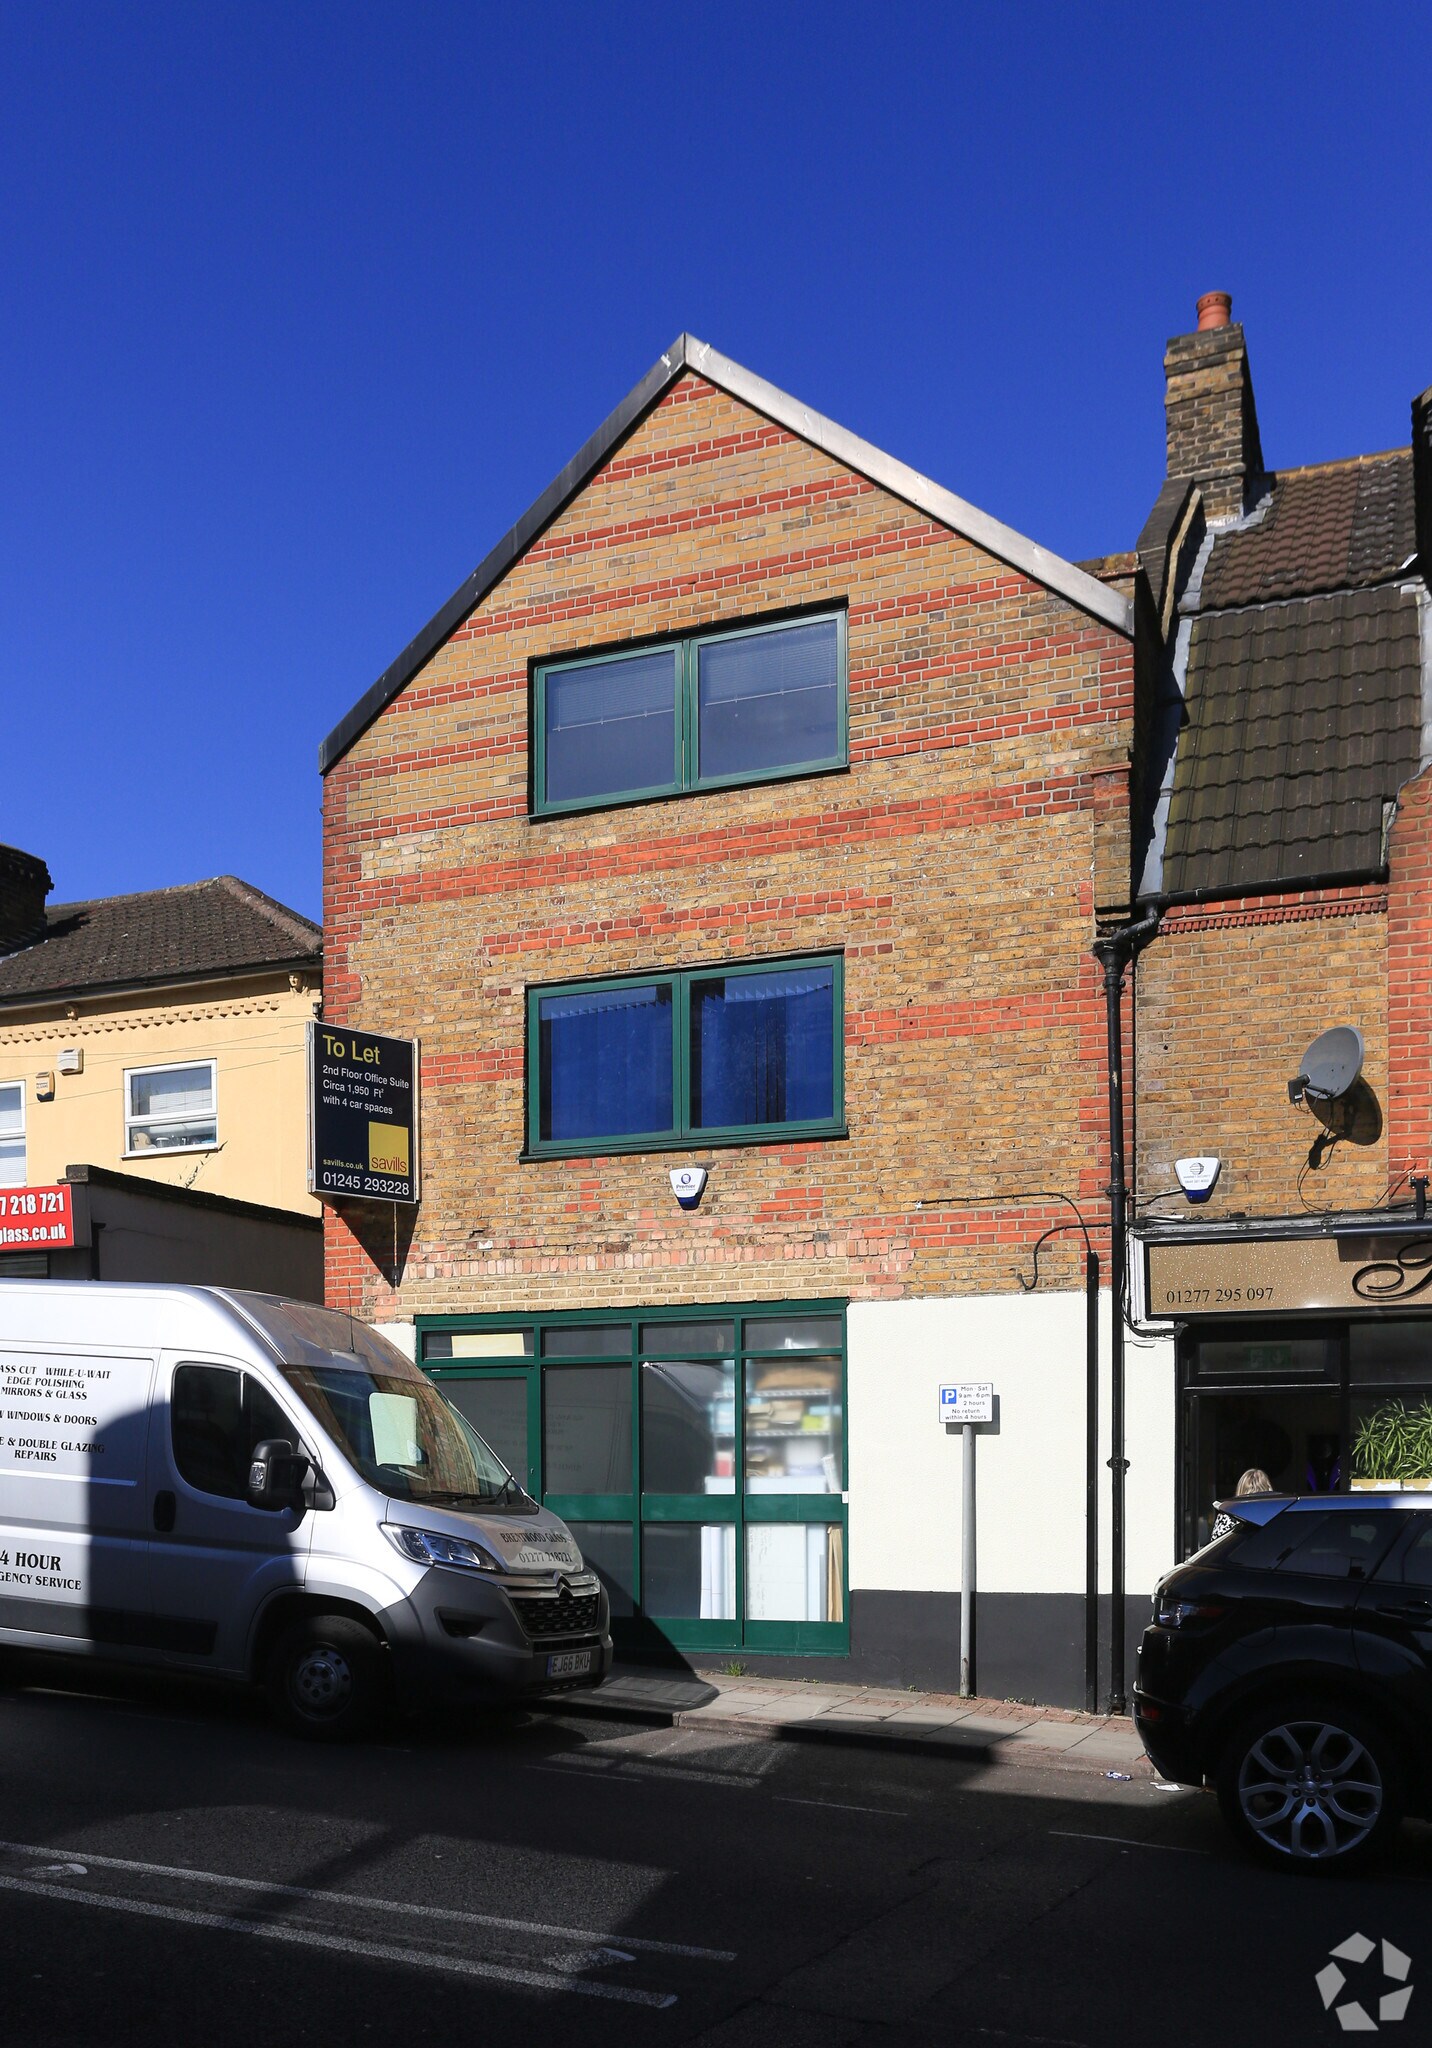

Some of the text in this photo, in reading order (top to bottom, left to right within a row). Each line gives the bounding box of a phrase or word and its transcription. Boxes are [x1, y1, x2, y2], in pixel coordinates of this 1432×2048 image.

[322, 1034, 380, 1065] To Let
[322, 1064, 410, 1089] 2nd Floor Office Suite
[322, 1080, 346, 1092] Circa
[348, 1084, 370, 1096] 1,950
[322, 1094, 393, 1115] with 4 car spaces
[322, 1158, 364, 1170] savills.co.uk
[371, 1156, 407, 1173] savills
[323, 1171, 410, 1196] 01245 293228
[10, 1194, 36, 1215] 218
[39, 1192, 64, 1213] 721
[1166, 1287, 1274, 1304] 01277 295 097
[19, 1366, 37, 1374] CUT
[46, 1367, 111, 1379] WHILE-U-WAIT
[7, 1376, 85, 1389] EDGE POLISHING
[1, 1386, 87, 1400] MIRRORS & GLASS
[7, 1410, 50, 1422] WINDOWS
[53, 1414, 61, 1422] &
[64, 1414, 98, 1426] DOORS
[7, 1437, 16, 1446] &
[18, 1438, 58, 1450] DOUBLE
[61, 1442, 105, 1454] GLAZING
[14, 1450, 56, 1462] REPAIRS
[15, 1552, 61, 1571] HOUR
[519, 1552, 544, 1563] 01277
[35, 1576, 82, 1590] SERVICE
[552, 1655, 573, 1672] EJ66
